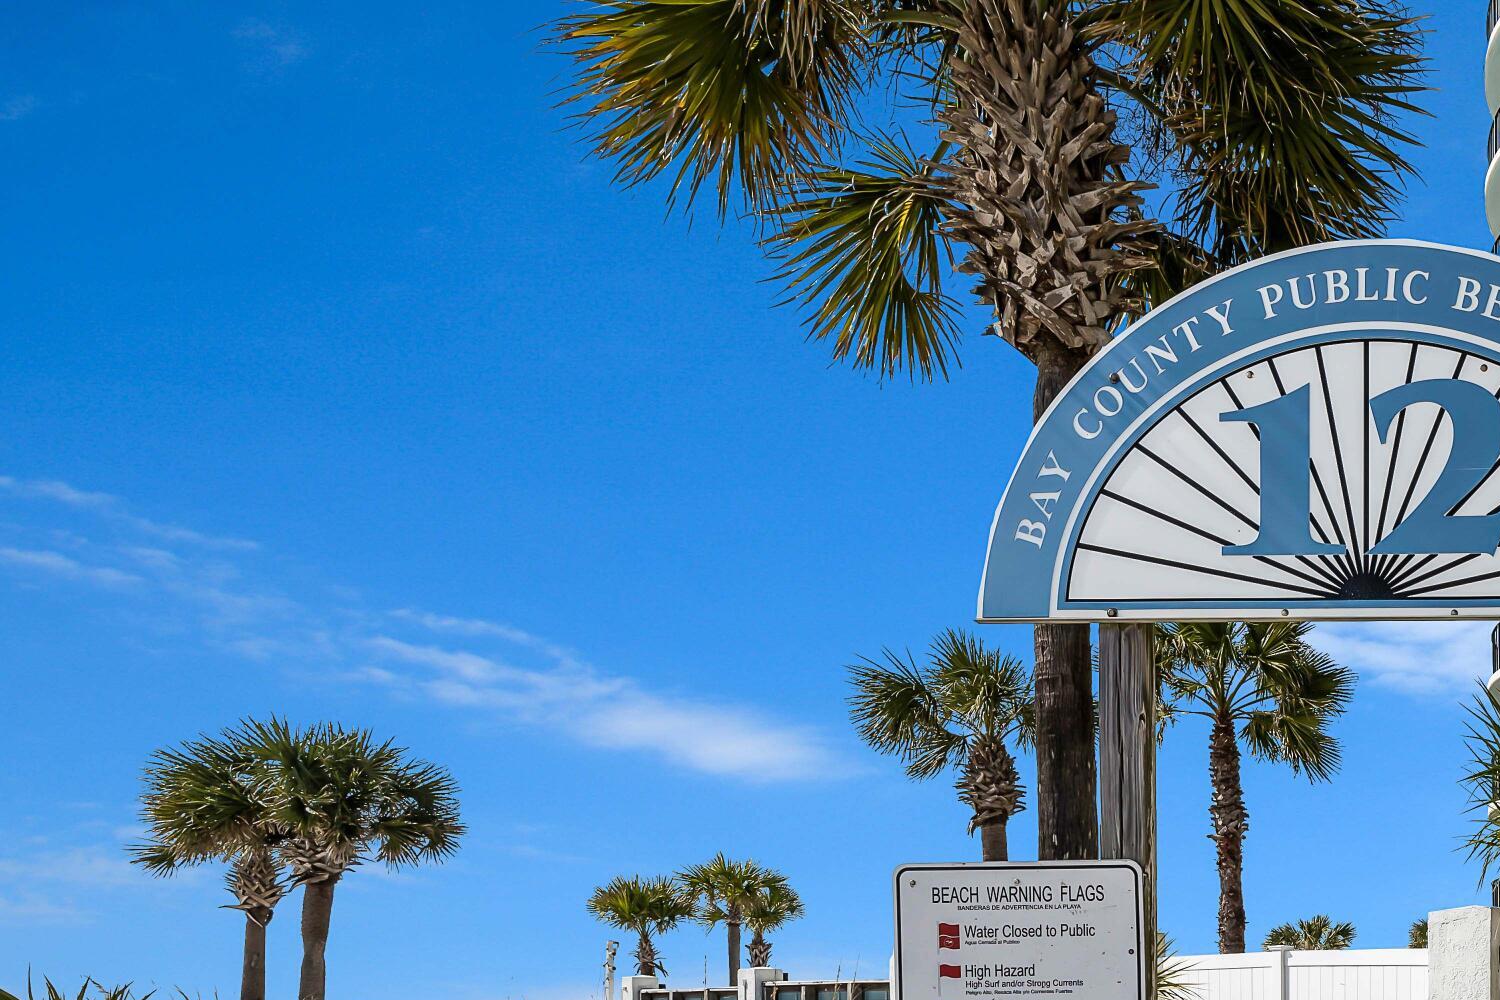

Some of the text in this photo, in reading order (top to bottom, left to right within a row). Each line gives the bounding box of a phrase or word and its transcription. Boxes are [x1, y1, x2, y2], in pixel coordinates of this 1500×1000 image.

[1014, 455, 1073, 549] BAY
[1072, 299, 1234, 441] COUNTY
[1262, 267, 1429, 318] PUBLIC
[931, 884, 1105, 904] BEACH WARNING FLAGS
[964, 923, 1096, 938] Water Closed to Public
[965, 964, 1035, 980] High Hazard
[965, 979, 1084, 989] High Surf and/or Strong Currents
